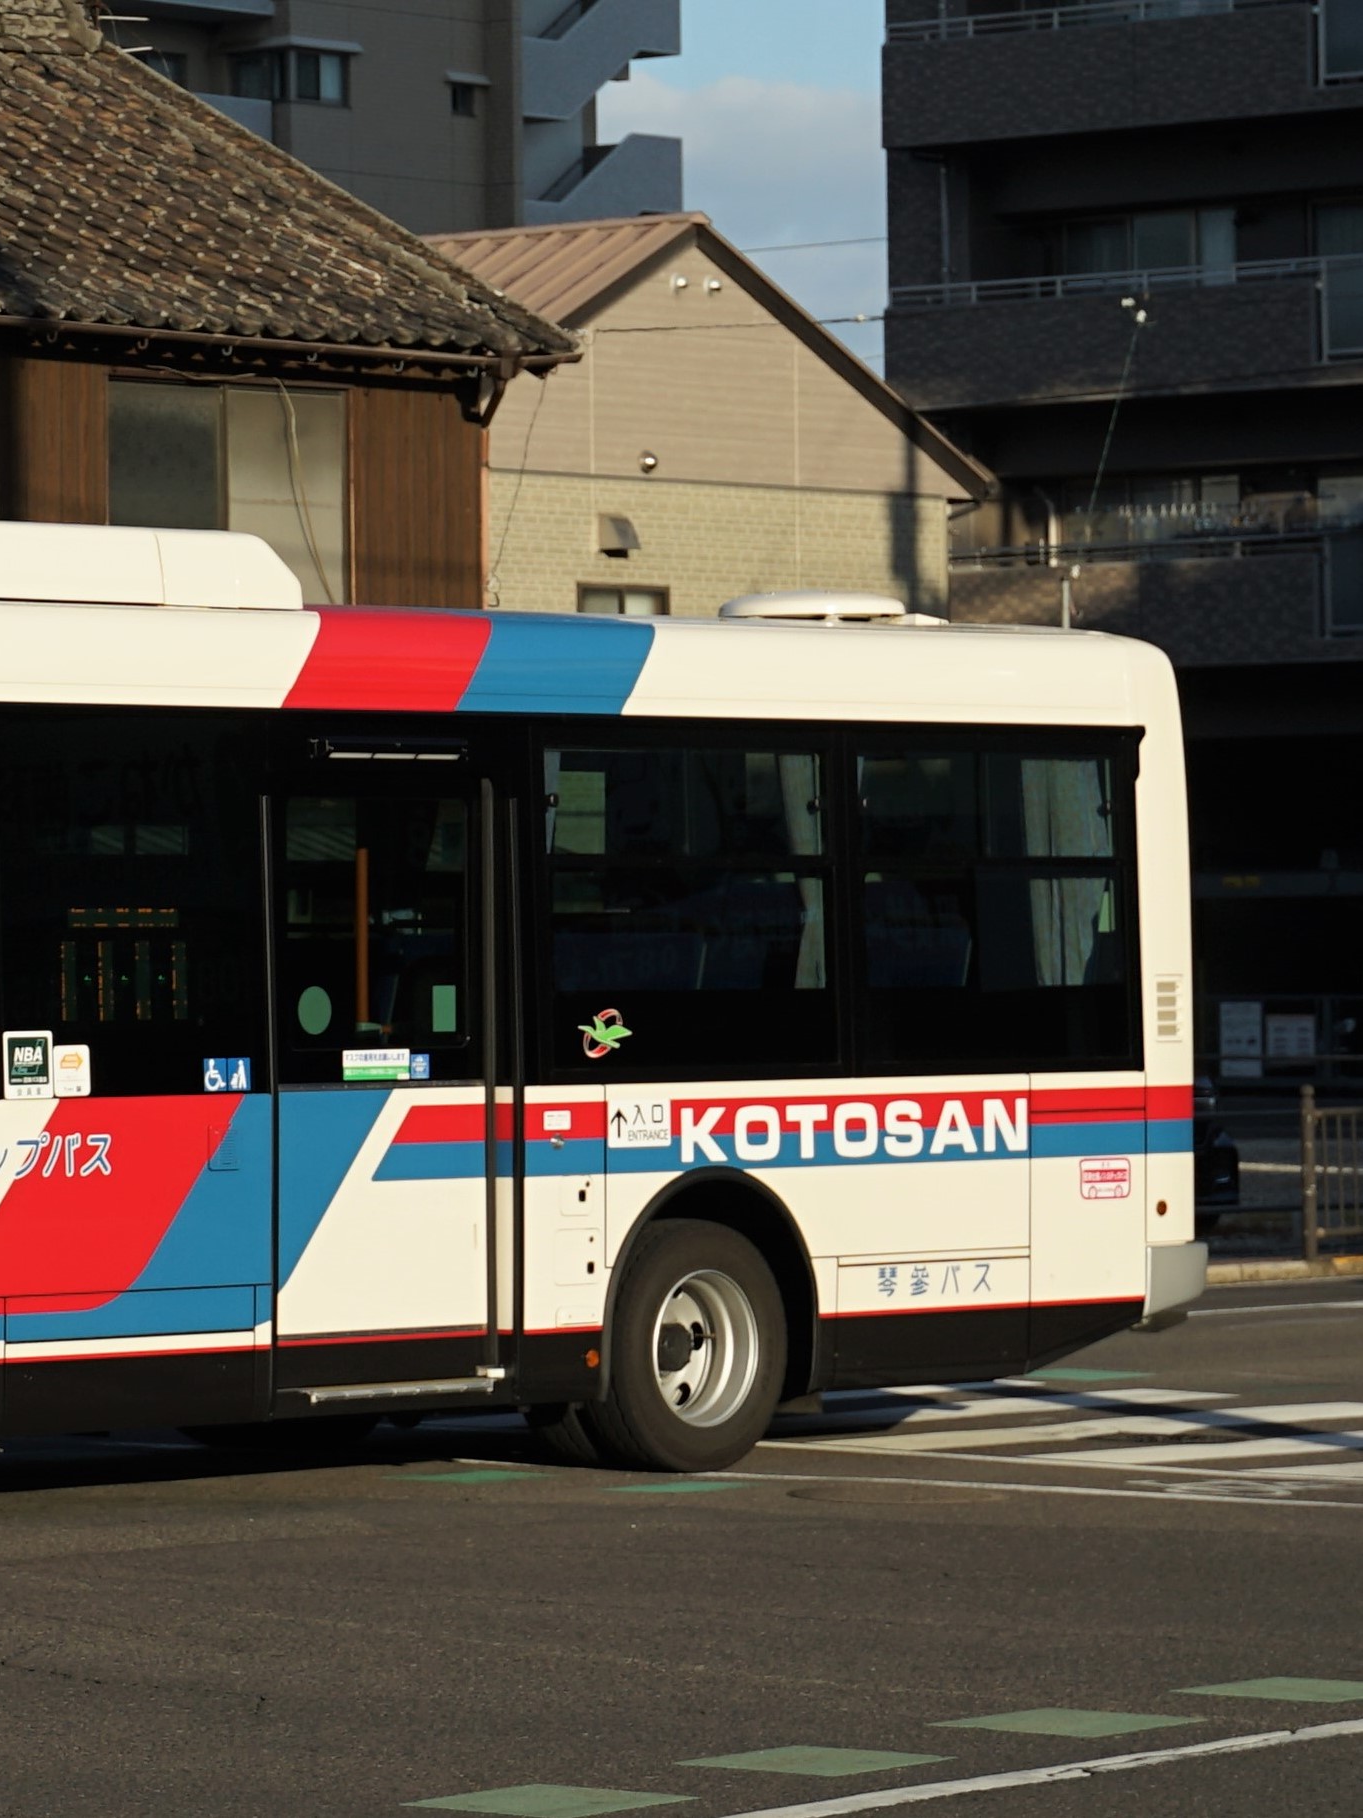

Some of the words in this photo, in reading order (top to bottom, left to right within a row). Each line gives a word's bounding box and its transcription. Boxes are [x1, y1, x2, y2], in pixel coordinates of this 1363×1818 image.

[14, 1046, 43, 1062] NBA
[632, 1104, 664, 1125] 入口
[627, 1129, 669, 1141] ENTRANCE
[680, 1098, 1028, 1163] KOTOSAN
